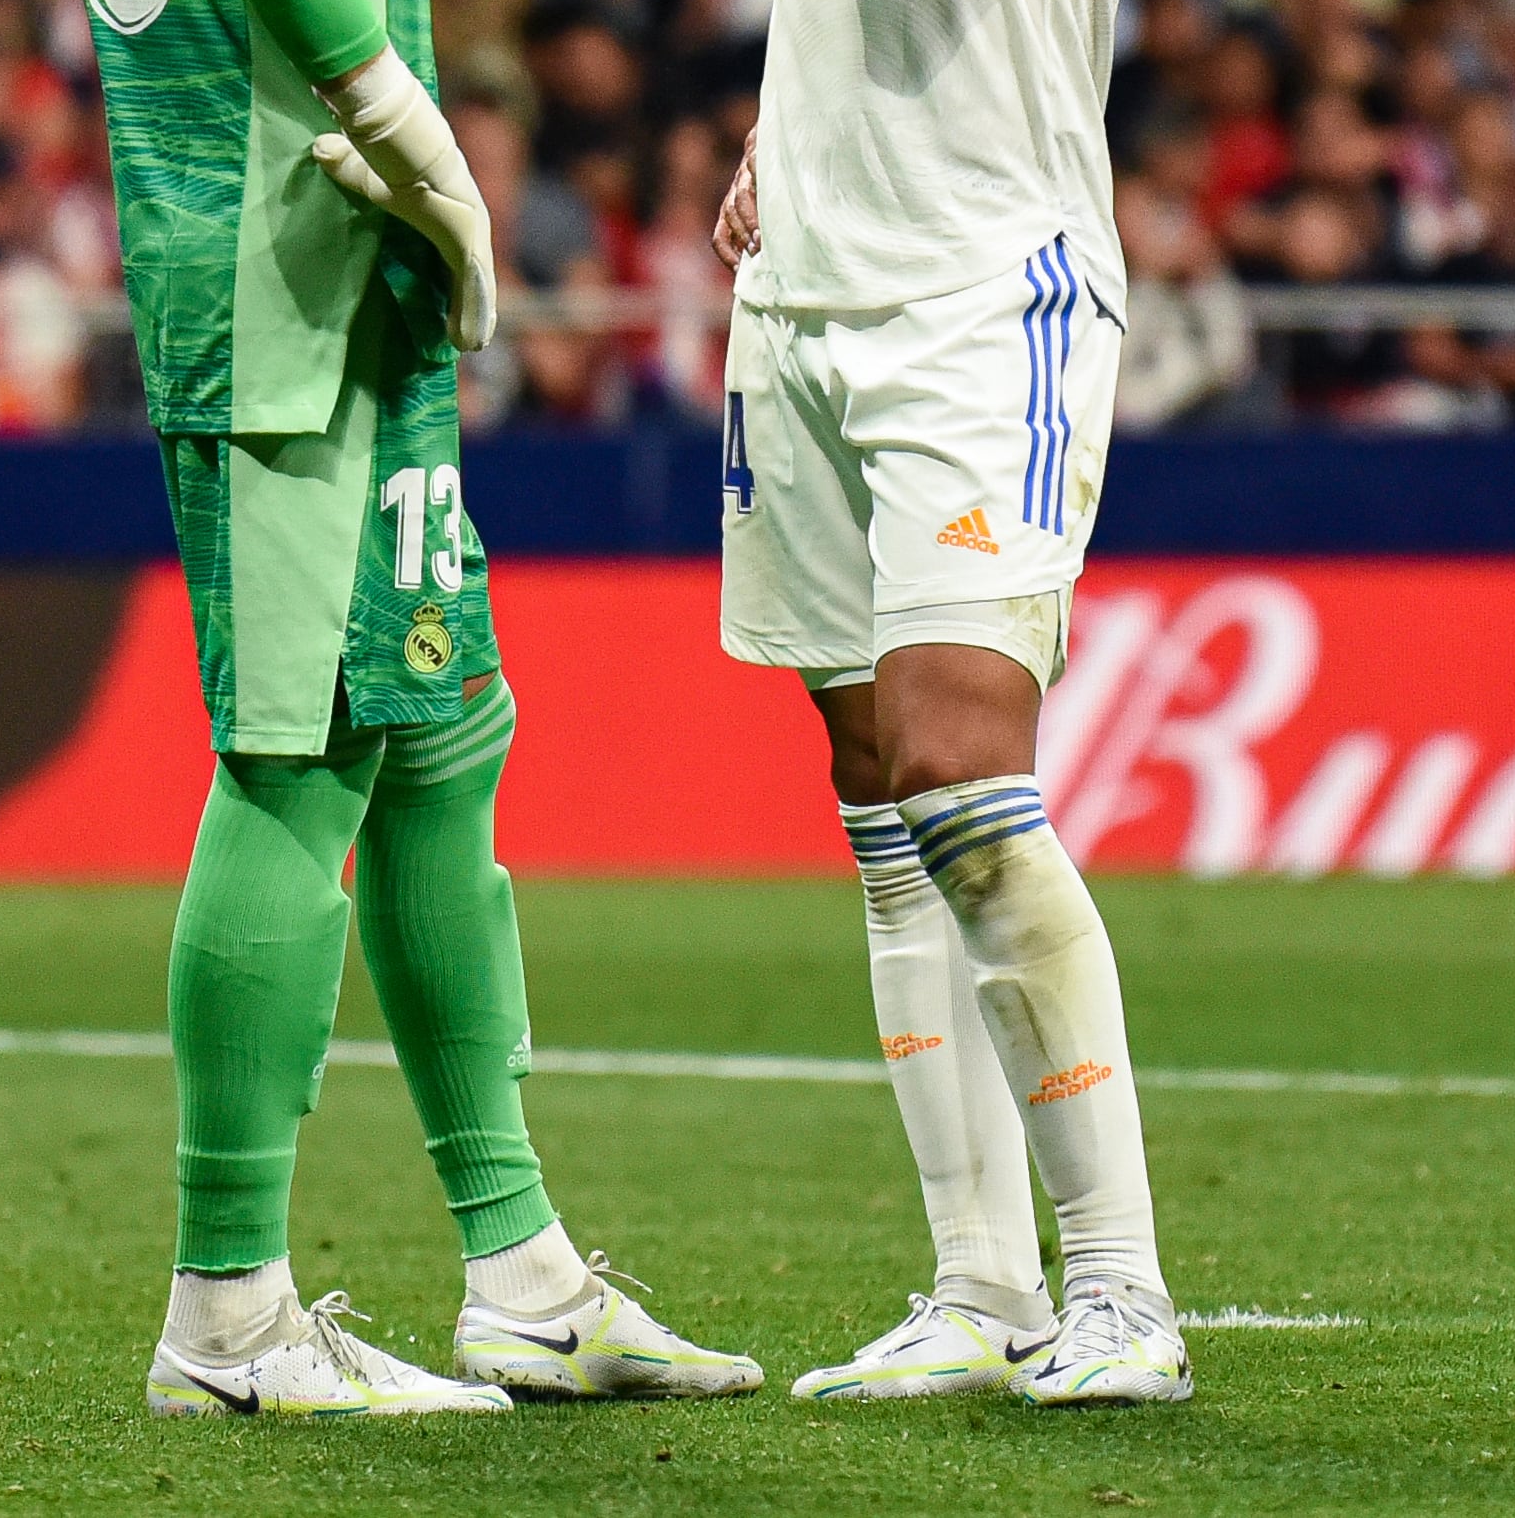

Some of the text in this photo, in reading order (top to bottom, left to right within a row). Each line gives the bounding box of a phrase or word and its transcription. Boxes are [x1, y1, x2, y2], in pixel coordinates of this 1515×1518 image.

[380, 463, 463, 593] 13
[936, 532, 999, 555] adidas
[1029, 1066, 1112, 1105] MADRID
[1041, 1059, 1097, 1090] REAL
